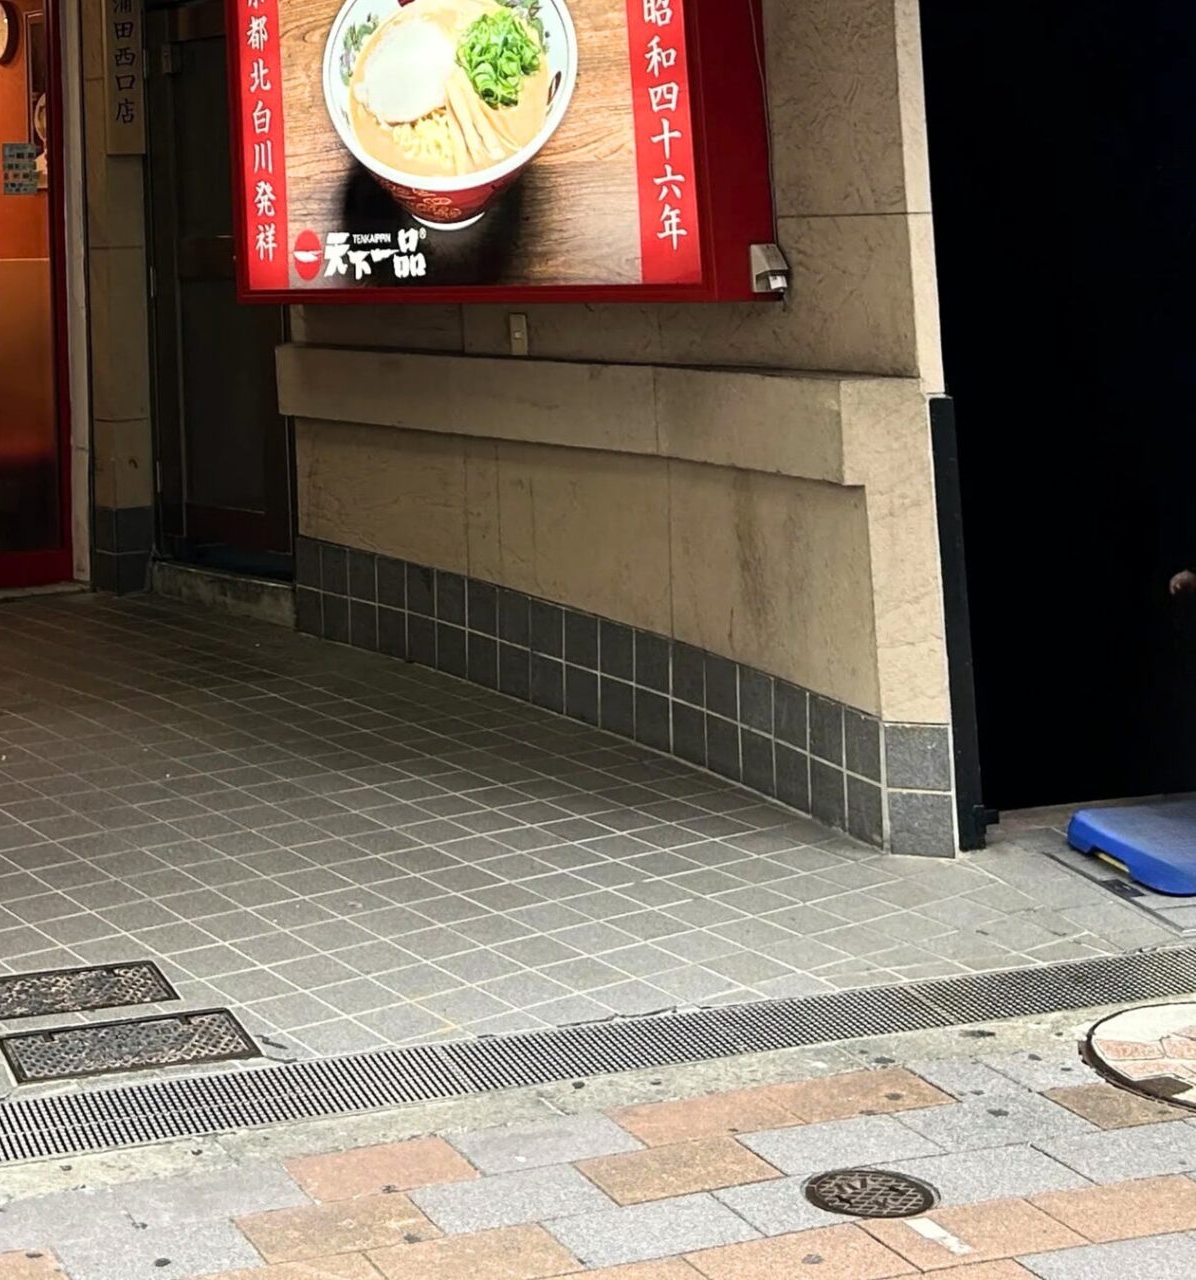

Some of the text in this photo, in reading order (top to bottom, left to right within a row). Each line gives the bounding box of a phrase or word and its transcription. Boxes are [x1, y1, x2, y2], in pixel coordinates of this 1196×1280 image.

[324, 228, 426, 280] 天下一品
[352, 233, 391, 244] TENKAIPPIN
